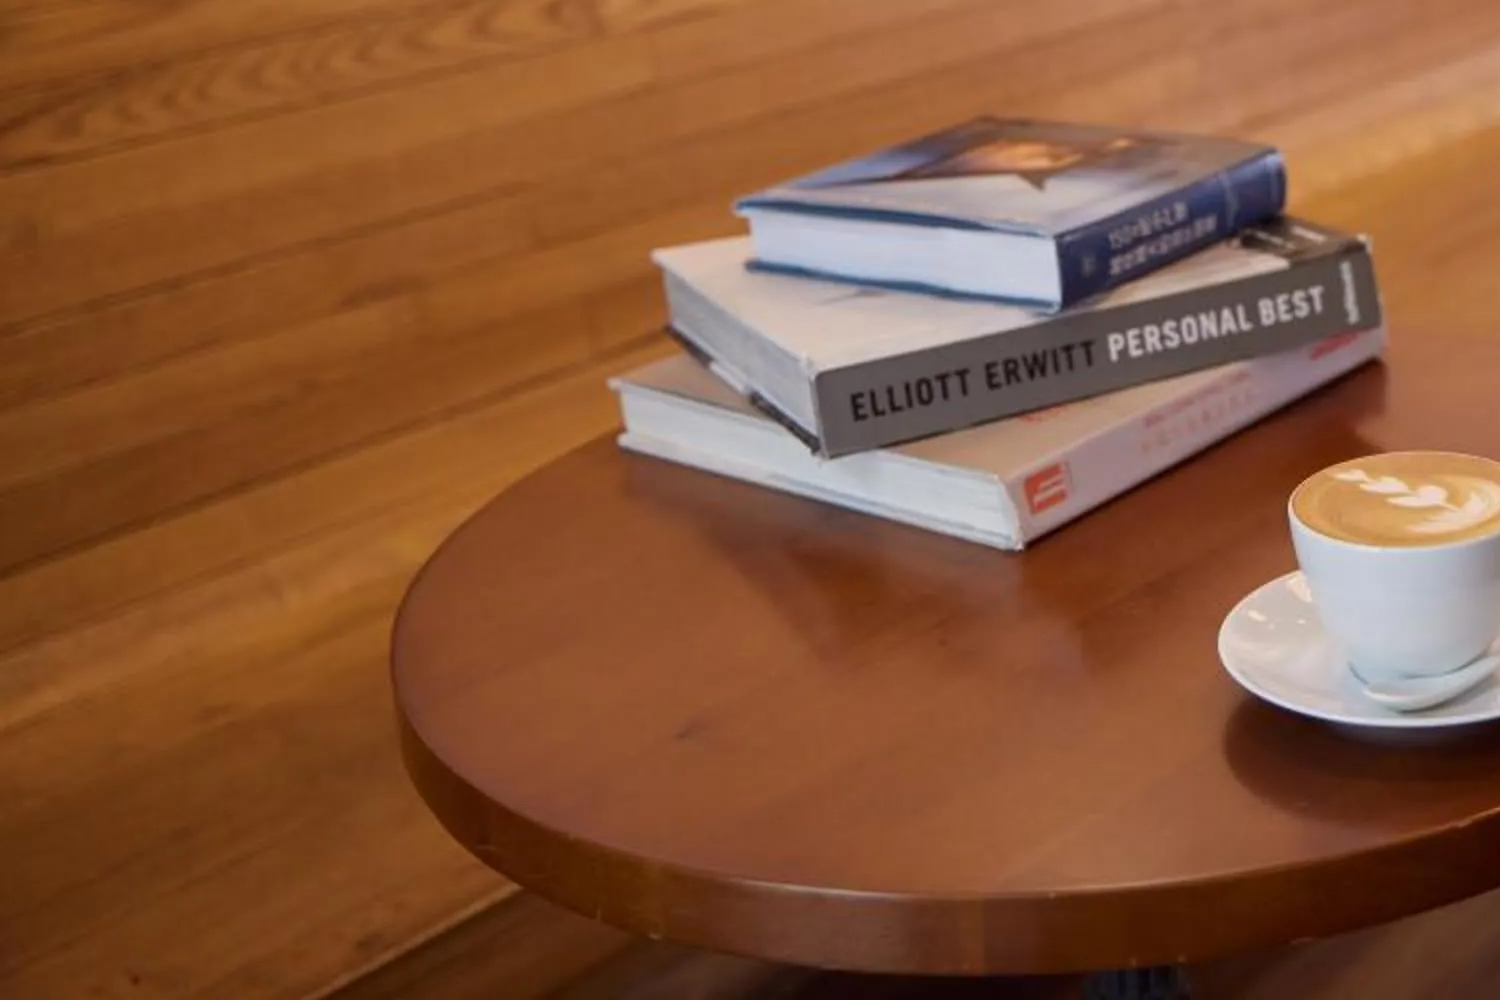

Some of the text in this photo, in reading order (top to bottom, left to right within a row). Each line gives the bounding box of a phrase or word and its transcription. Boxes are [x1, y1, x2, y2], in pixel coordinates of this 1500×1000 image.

[850, 368, 971, 422] ELLIOTT
[985, 339, 1096, 391] ERWITT
[1107, 303, 1254, 362] PERSONAL
[1257, 285, 1324, 327] BEST
